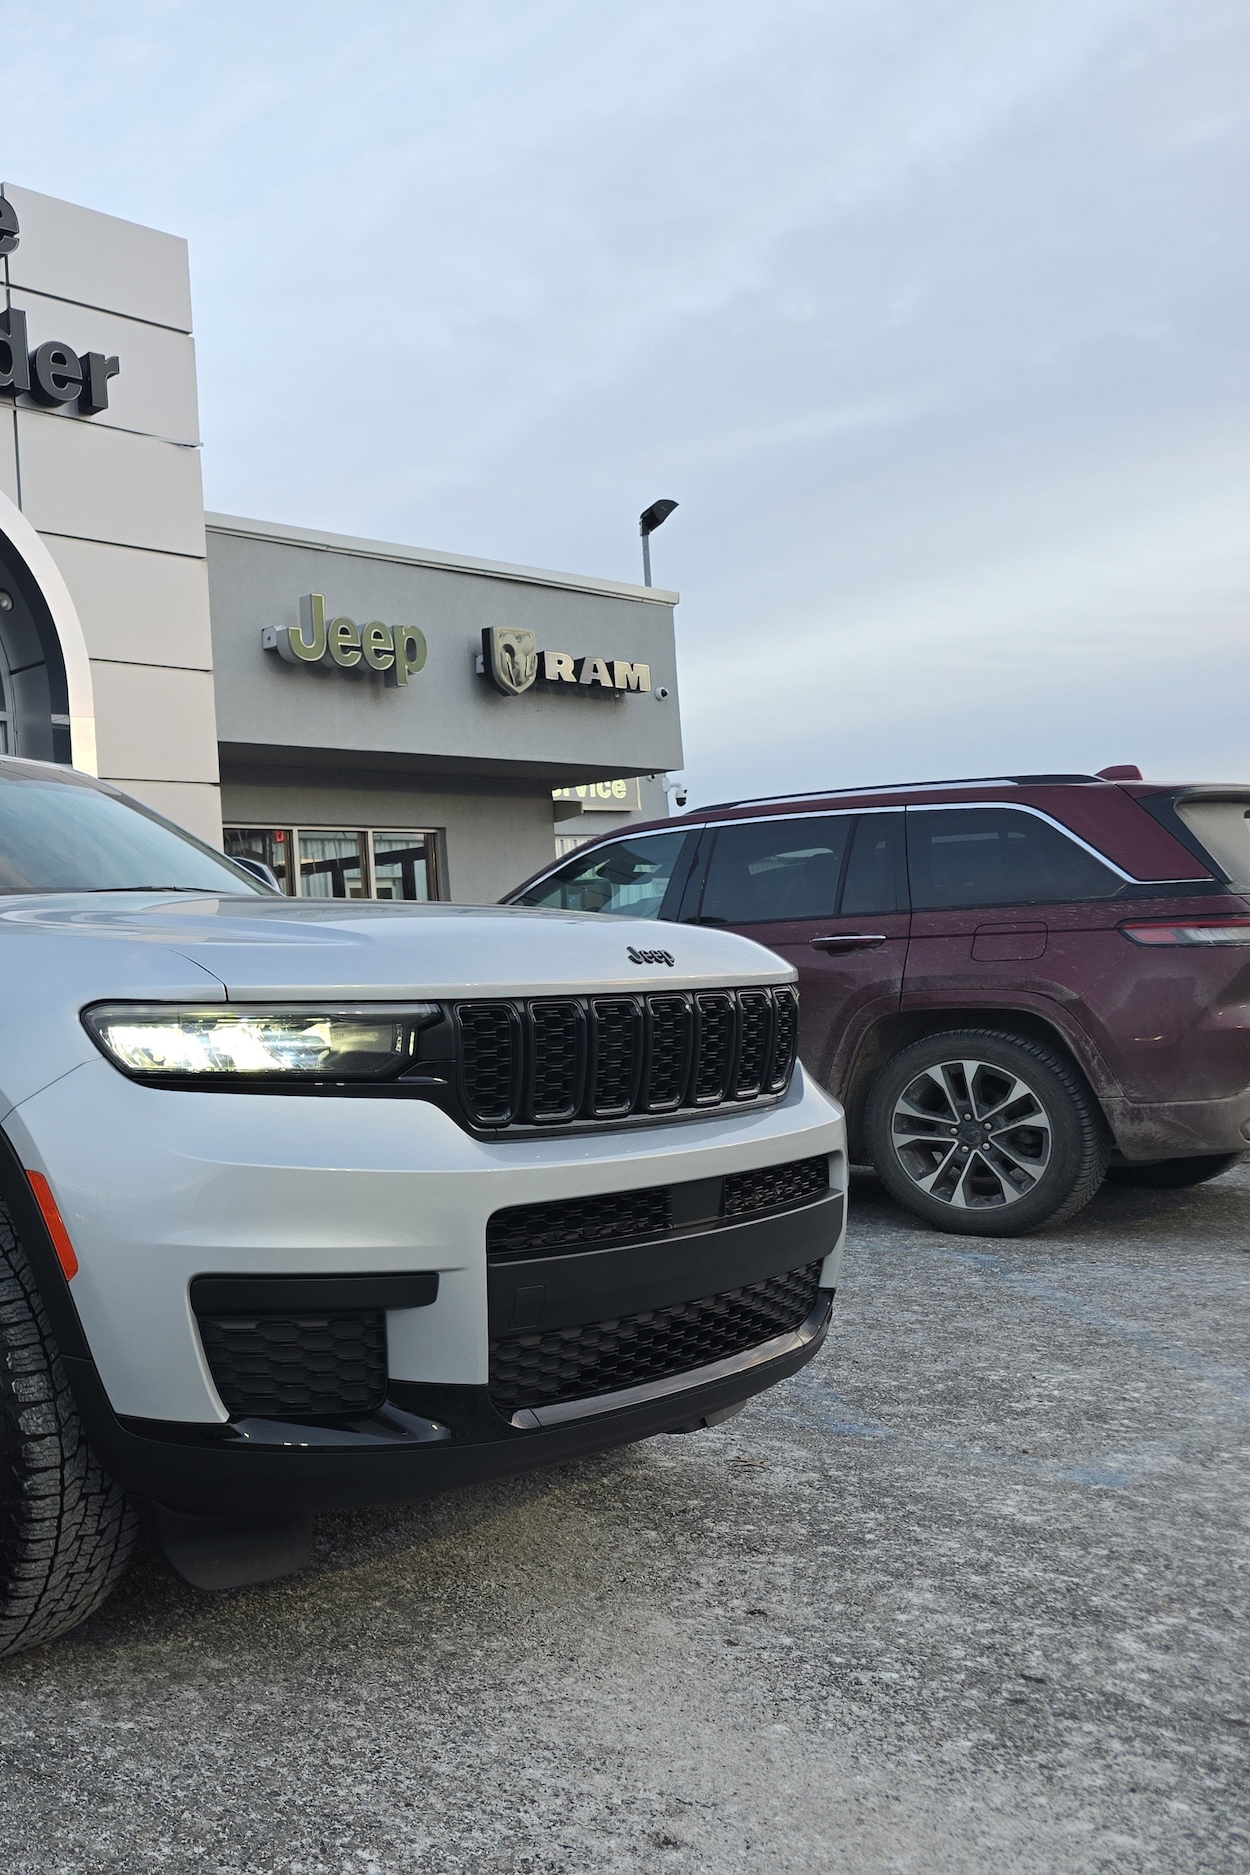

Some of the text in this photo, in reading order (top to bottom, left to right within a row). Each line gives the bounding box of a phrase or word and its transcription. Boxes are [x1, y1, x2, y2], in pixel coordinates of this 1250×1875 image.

[277, 592, 428, 688] Jeep
[538, 650, 652, 693] RAM
[626, 946, 675, 967] Jeep
